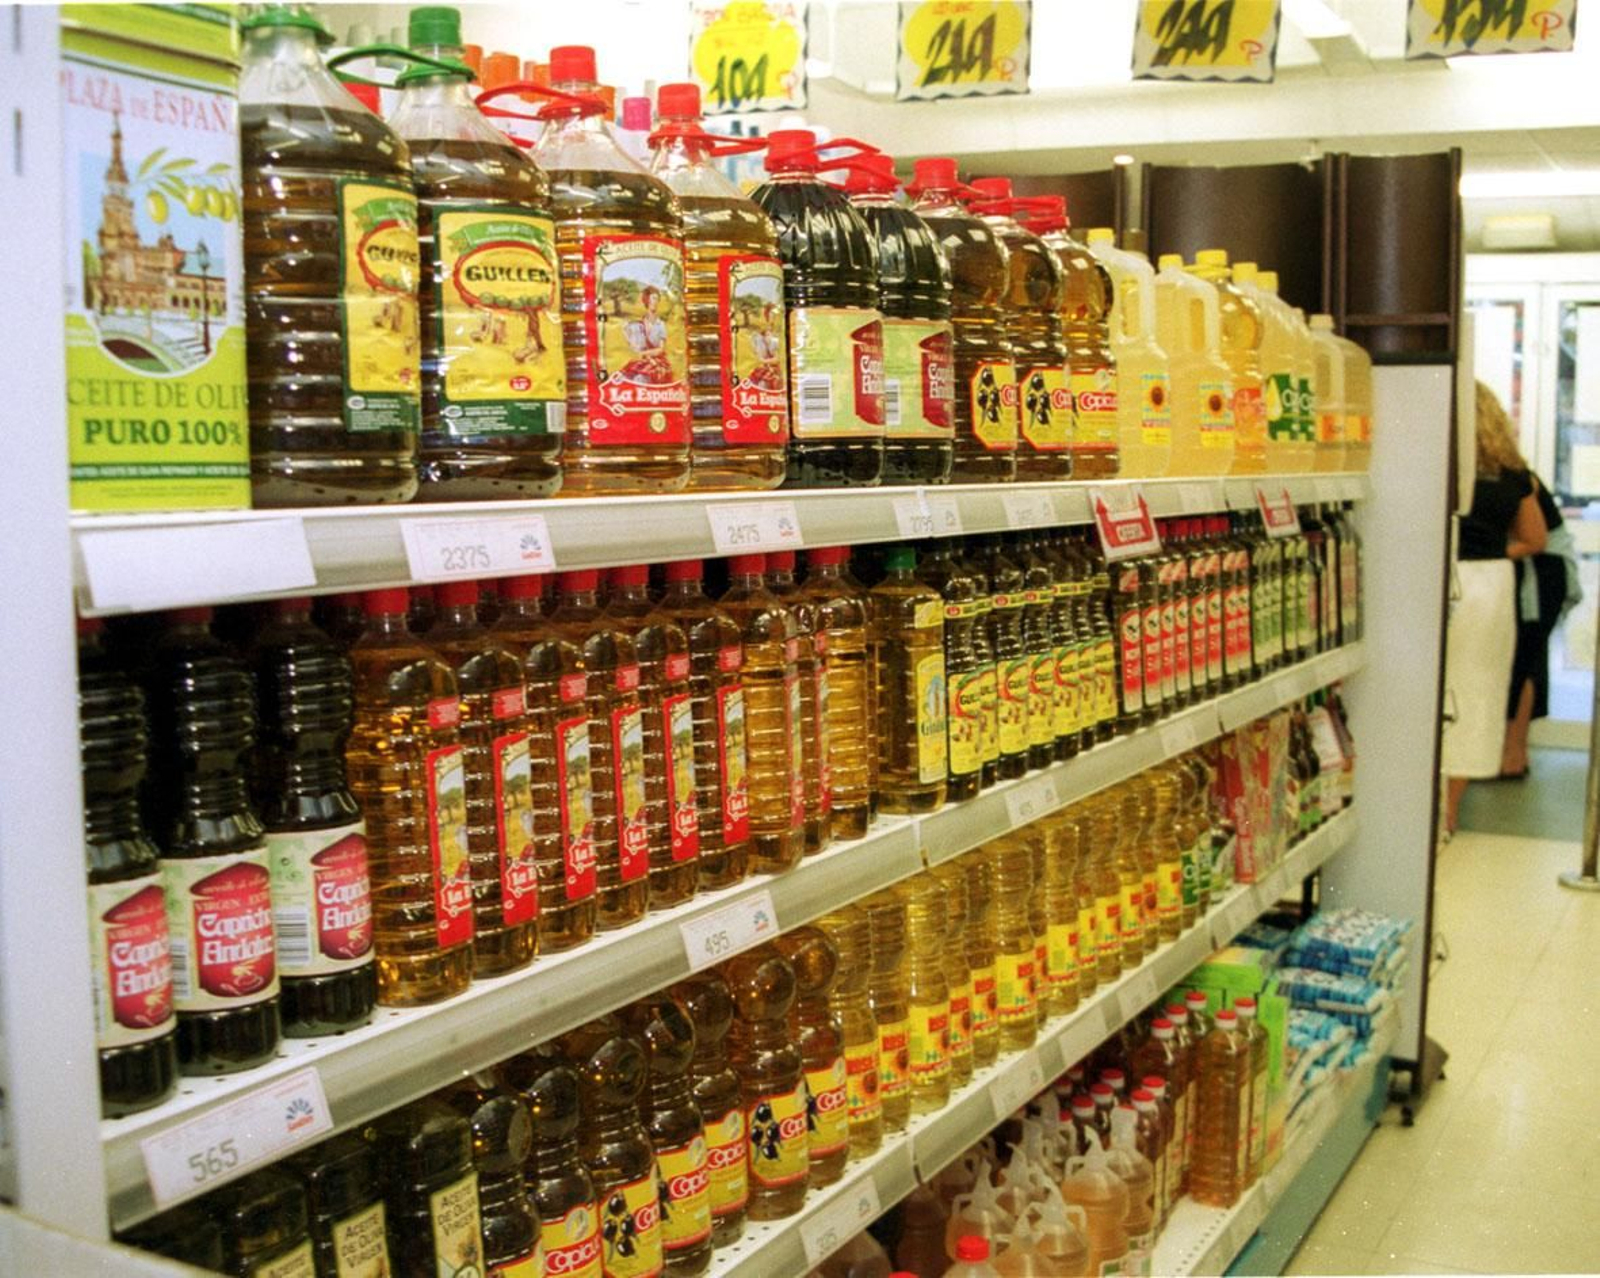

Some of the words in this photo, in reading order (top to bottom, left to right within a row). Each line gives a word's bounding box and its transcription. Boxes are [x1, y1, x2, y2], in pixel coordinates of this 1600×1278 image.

[154, 382, 187, 408] DE
[609, 387, 633, 402] La
[741, 392, 758, 405] La
[84, 419, 171, 446] PURO
[727, 524, 760, 544] 2475
[441, 546, 491, 570] 2375
[188, 1138, 240, 1183] 565
